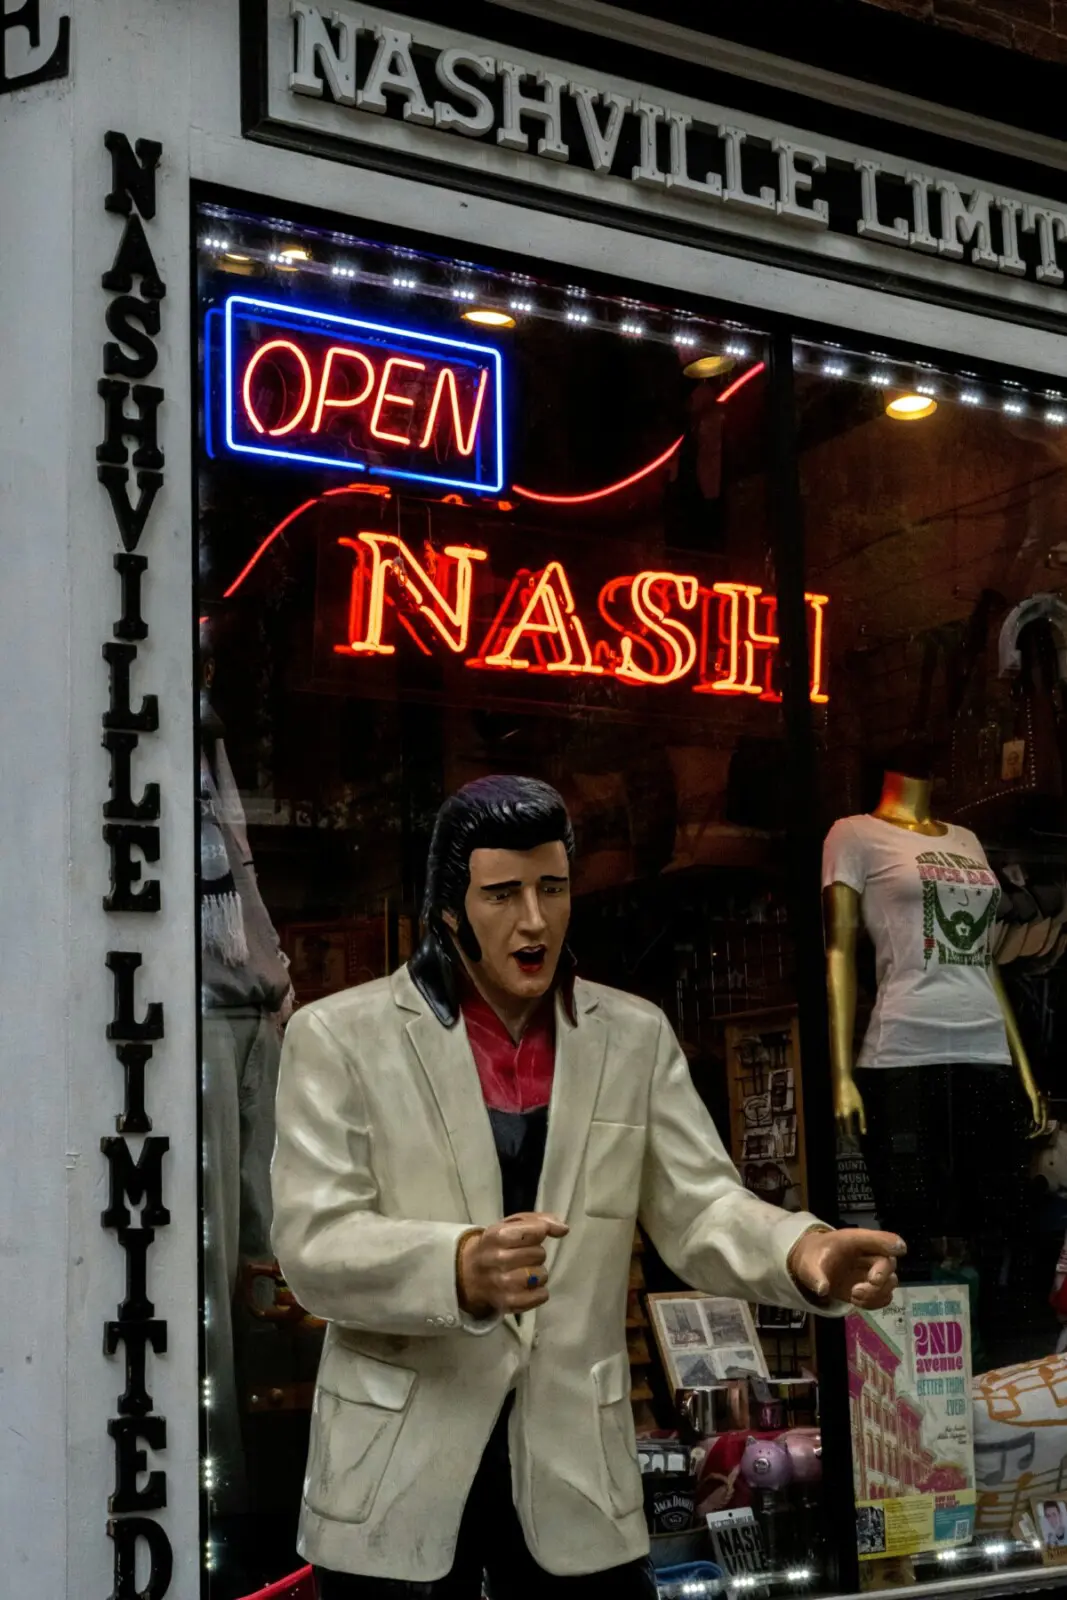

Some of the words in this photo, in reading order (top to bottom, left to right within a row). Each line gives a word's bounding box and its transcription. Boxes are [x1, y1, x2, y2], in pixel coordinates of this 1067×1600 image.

[289, 4, 829, 232] NASHVILLE
[853, 157, 1067, 284] LIMIT
[243, 339, 488, 457] OPEN
[96, 130, 166, 913] NASHVILLE
[340, 530, 830, 704] NASH
[100, 951, 173, 1600] LIMITED
[914, 1321, 963, 1356] 2ND
[916, 1356, 963, 1374] avenue
